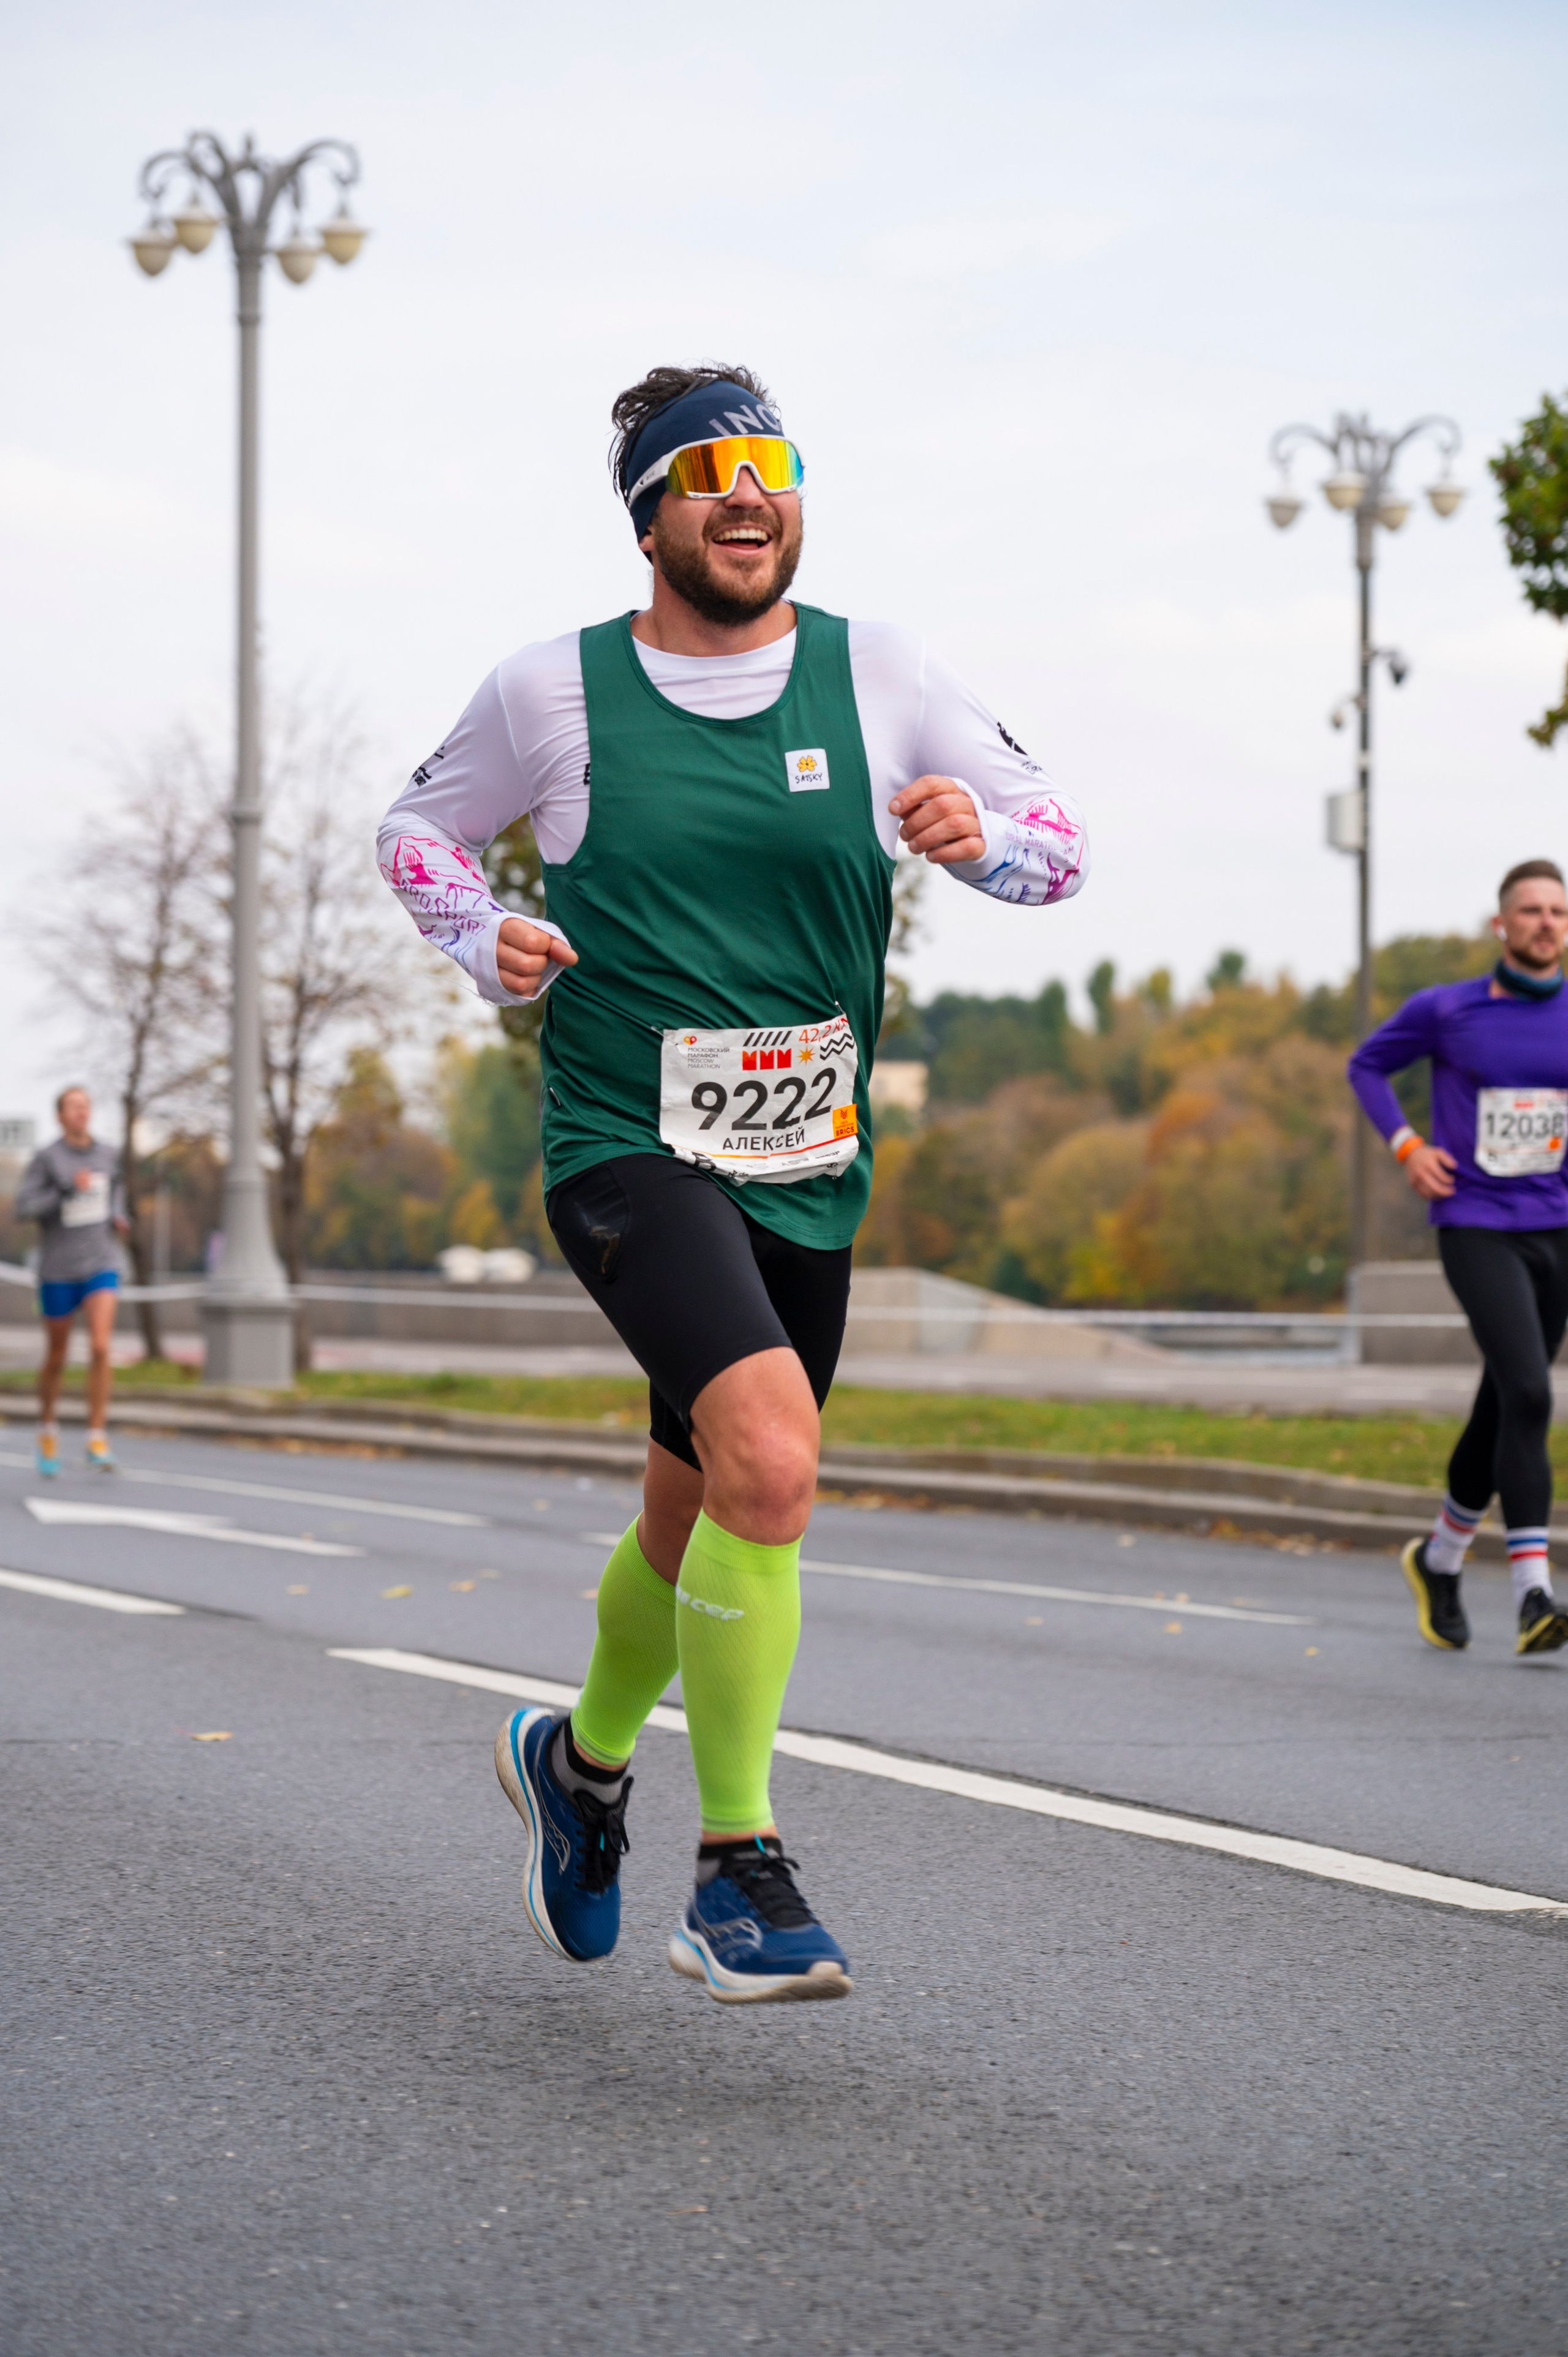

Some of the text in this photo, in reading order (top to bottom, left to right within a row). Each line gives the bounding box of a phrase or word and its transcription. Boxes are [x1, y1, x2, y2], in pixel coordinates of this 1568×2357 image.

[799, 1025, 832, 1044] 42,2
[691, 1067, 837, 1131] 9222
[722, 1126, 805, 1150] АЛЕКСЕЙ
[836, 1126, 854, 1137] BRICS
